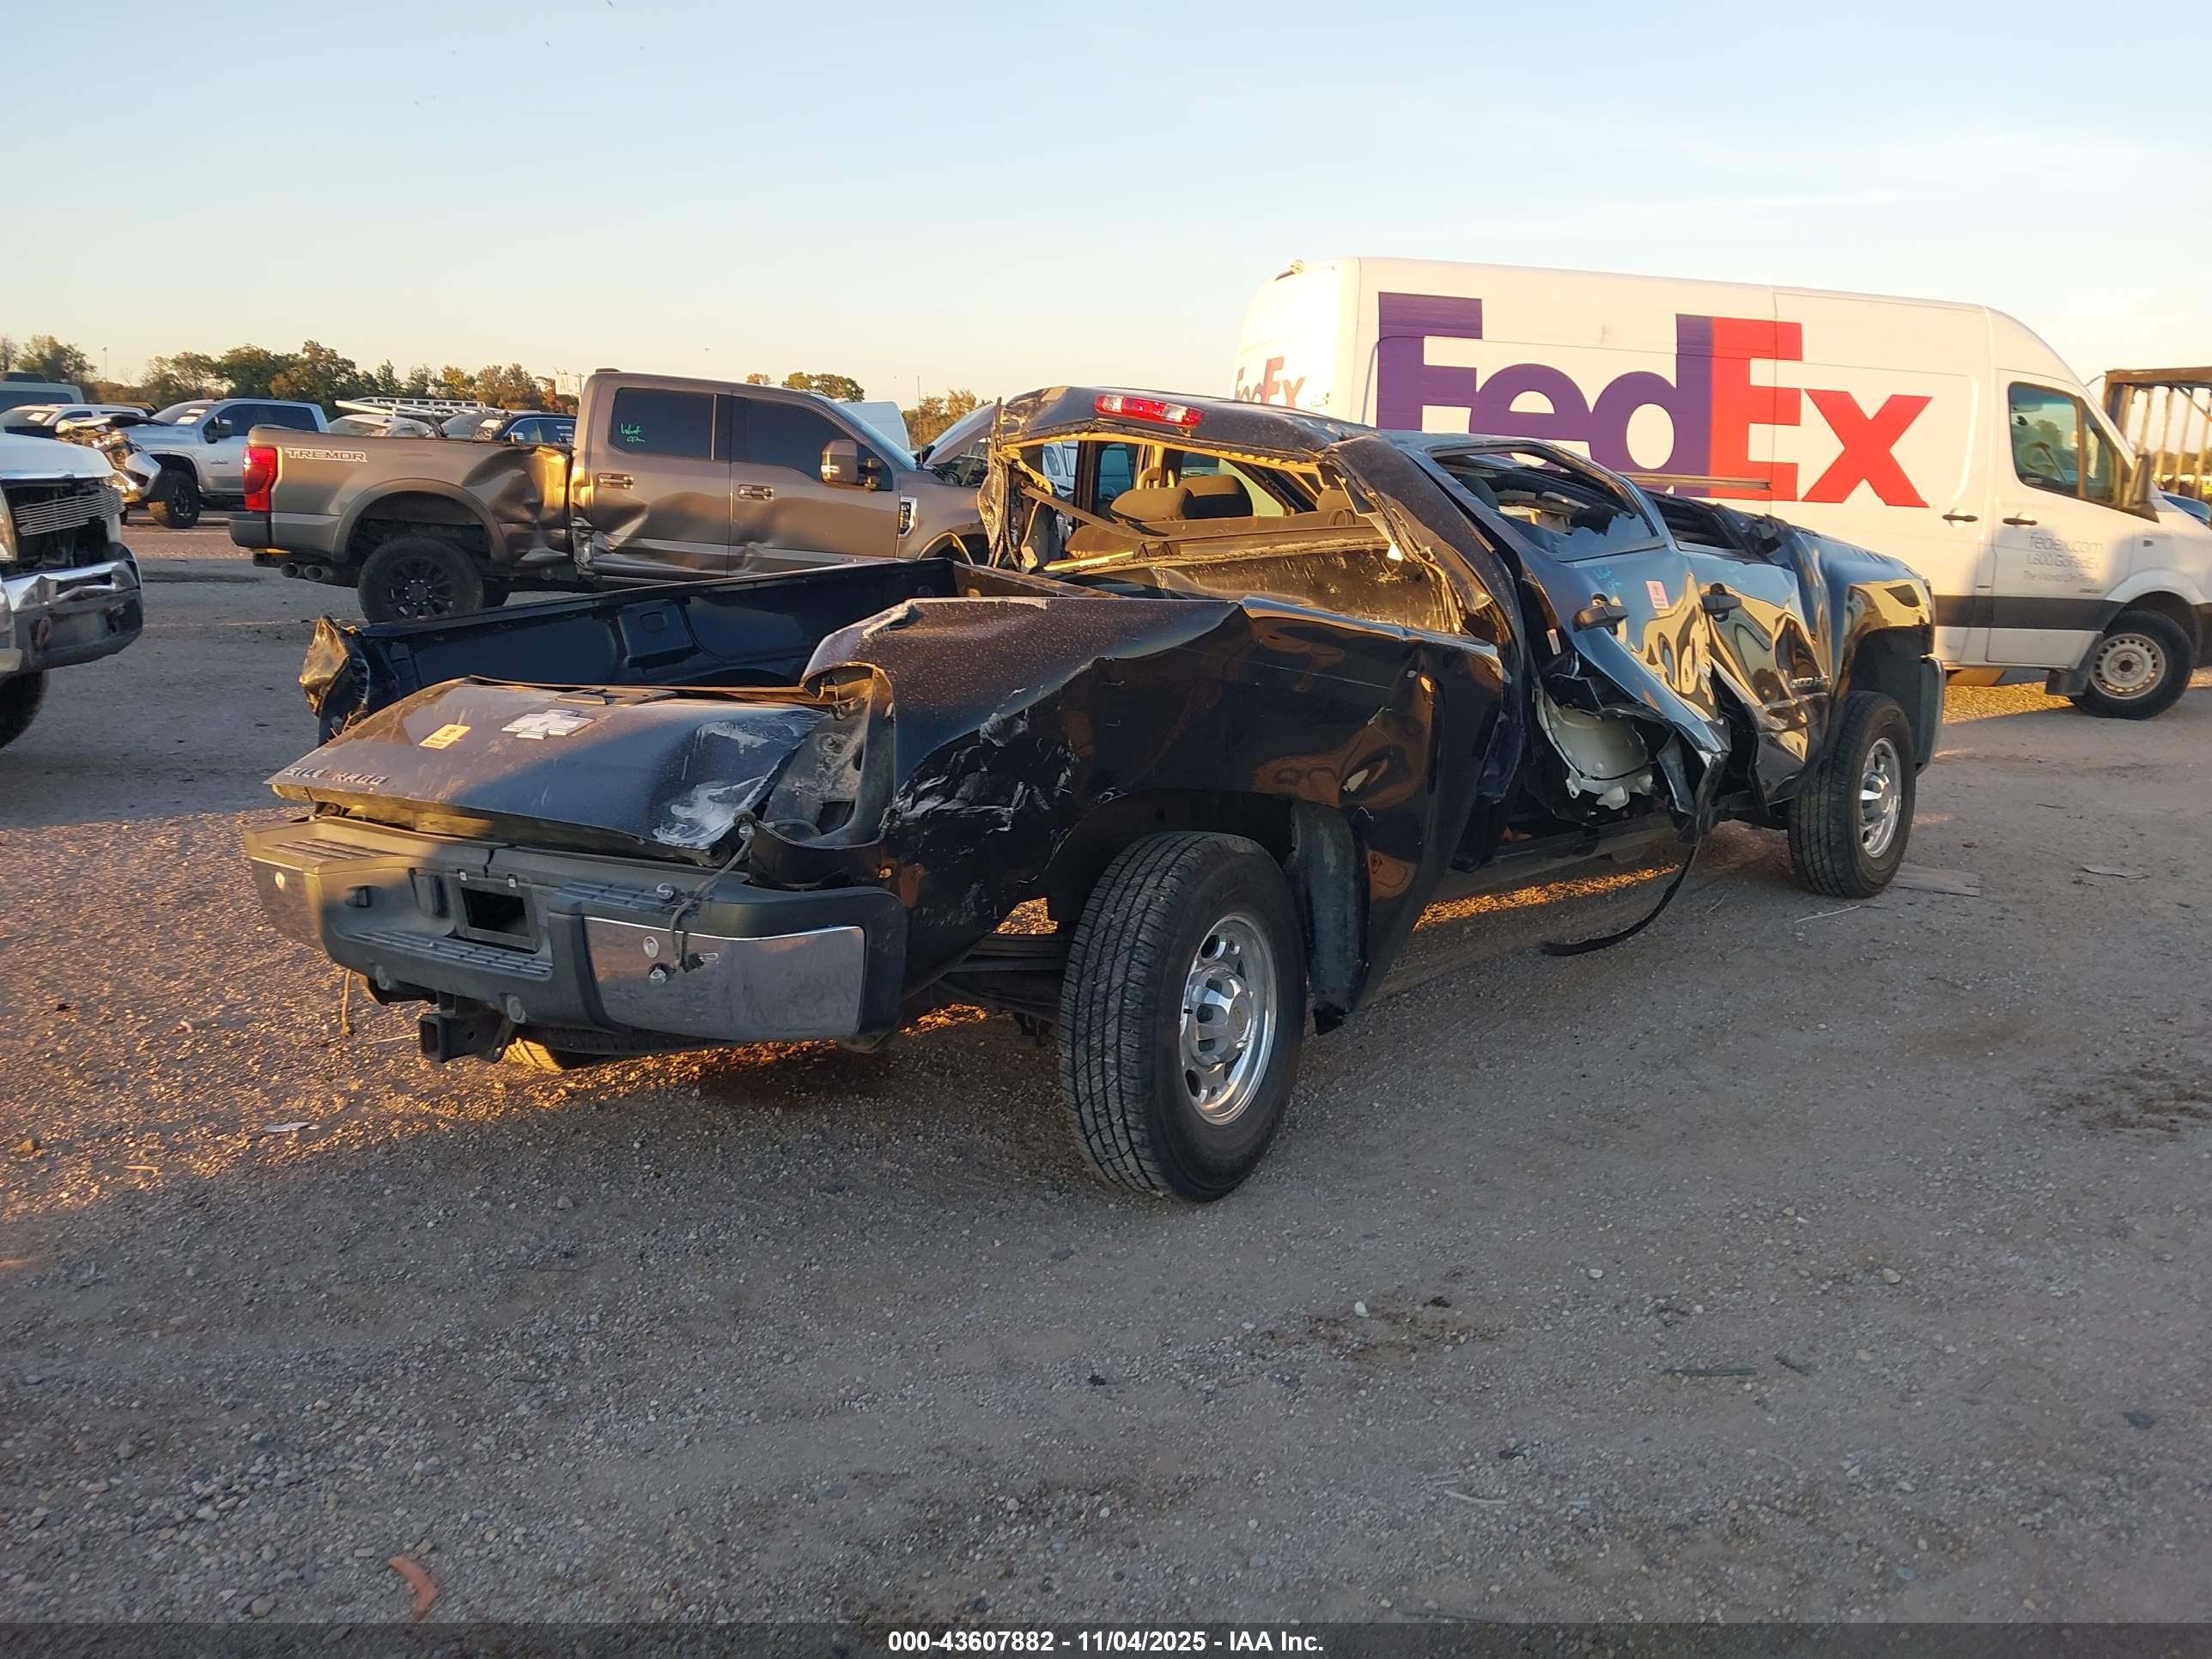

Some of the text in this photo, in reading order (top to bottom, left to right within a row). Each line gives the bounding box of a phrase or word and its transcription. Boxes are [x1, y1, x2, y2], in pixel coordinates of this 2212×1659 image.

[1376, 292, 1934, 508] FedEx
[285, 447, 368, 463] TREMOR
[285, 767, 390, 786] SILVRADO
